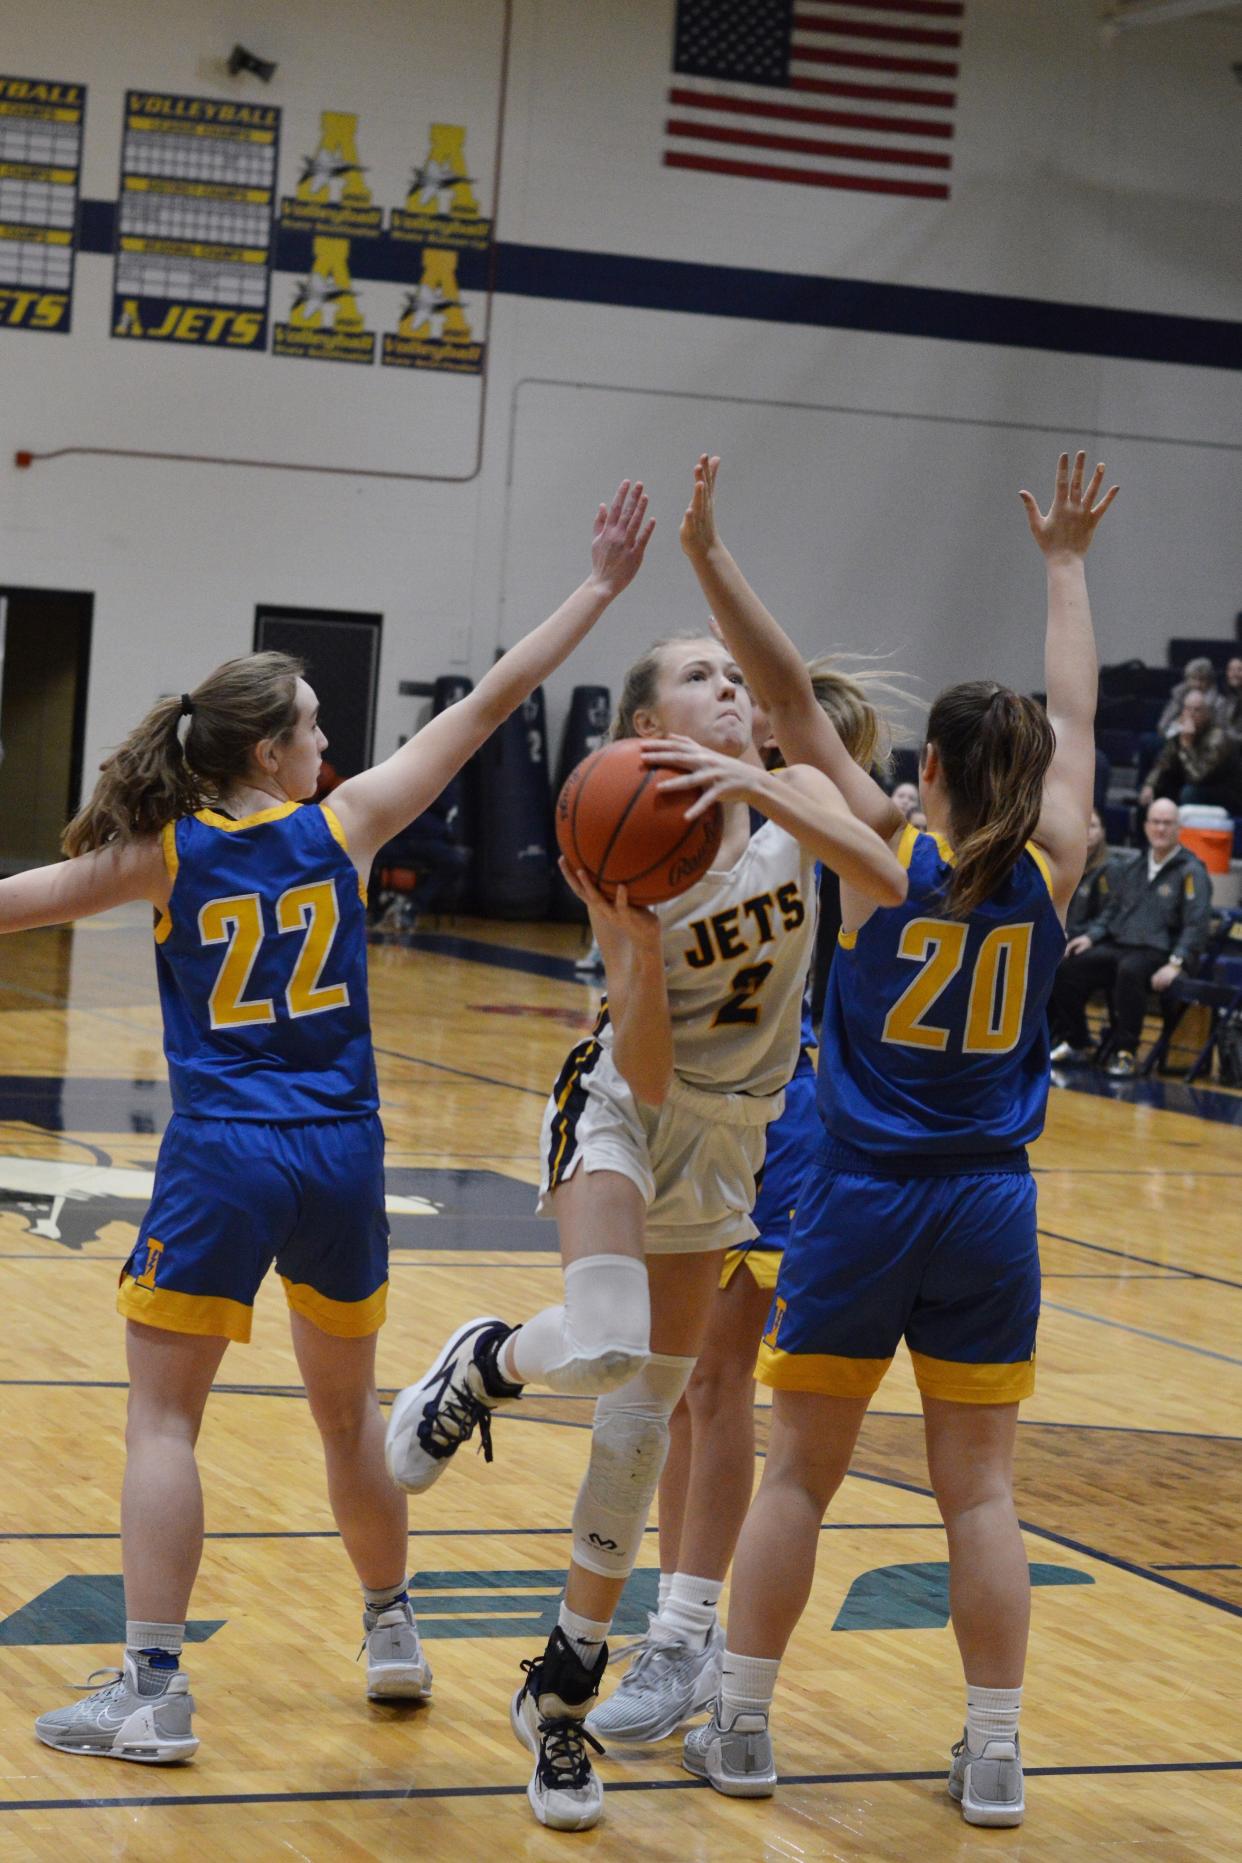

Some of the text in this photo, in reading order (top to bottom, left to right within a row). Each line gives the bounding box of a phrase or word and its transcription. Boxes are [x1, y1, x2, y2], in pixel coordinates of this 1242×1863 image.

[128, 94, 276, 128] VOLLEYBALL
[147, 305, 265, 345] JETS
[198, 878, 350, 1030] 22
[683, 880, 806, 970] JETS
[709, 958, 773, 1029] 2
[881, 916, 1035, 1054] 20
